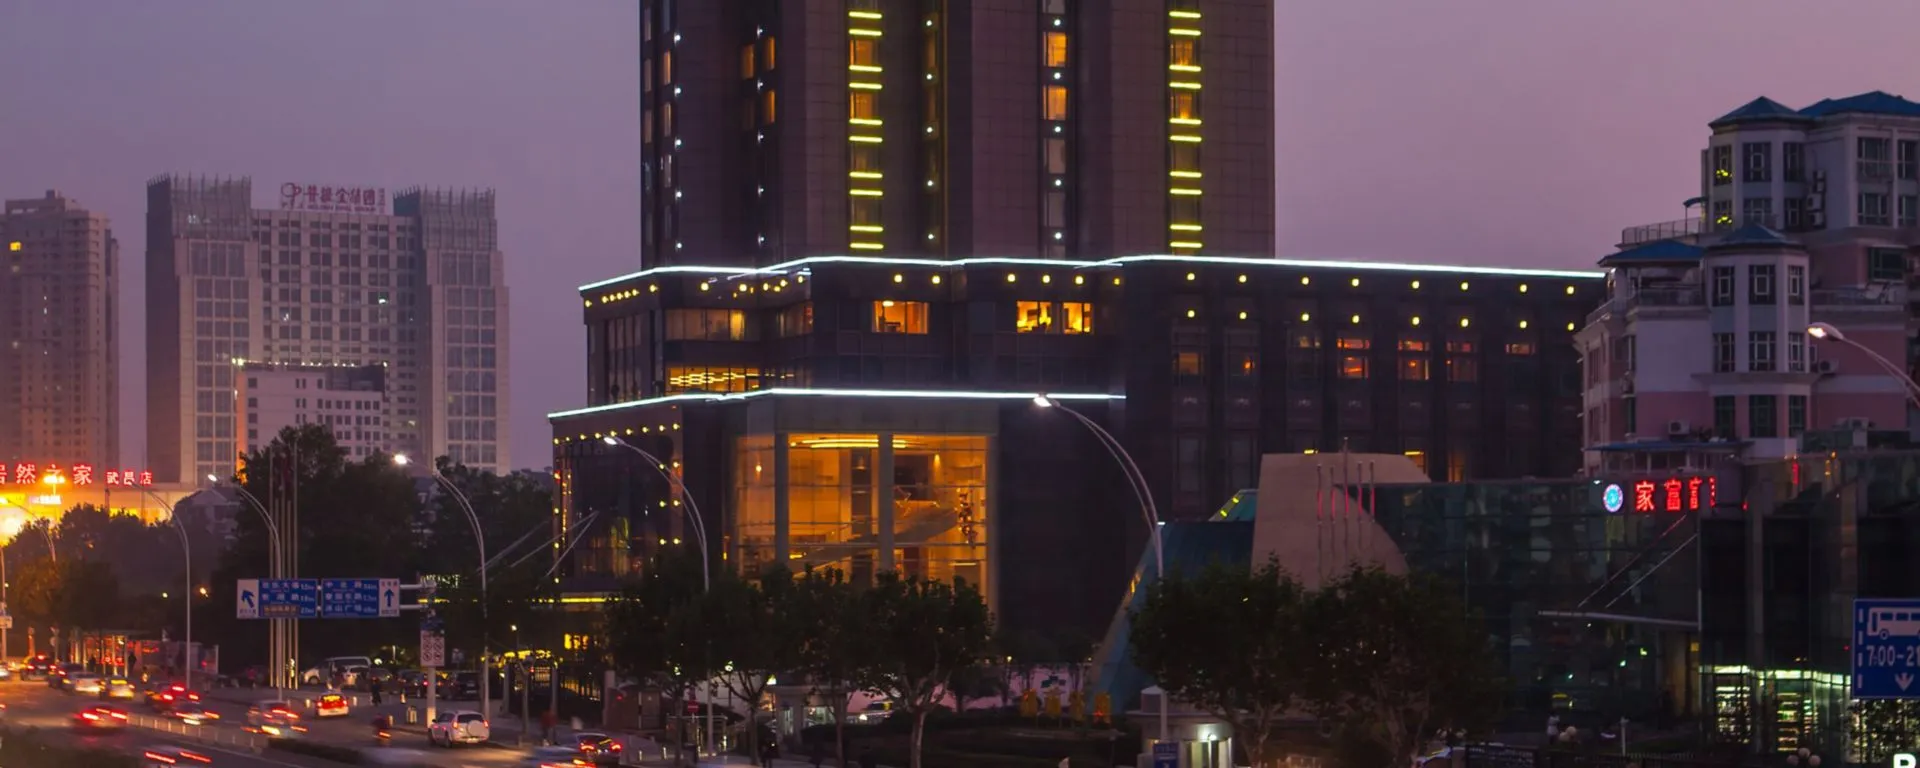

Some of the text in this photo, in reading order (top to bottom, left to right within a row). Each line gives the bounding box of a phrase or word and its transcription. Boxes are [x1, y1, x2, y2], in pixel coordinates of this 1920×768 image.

[106, 471, 153, 486] 武昌店
[1634, 477, 1716, 511] 家富富
